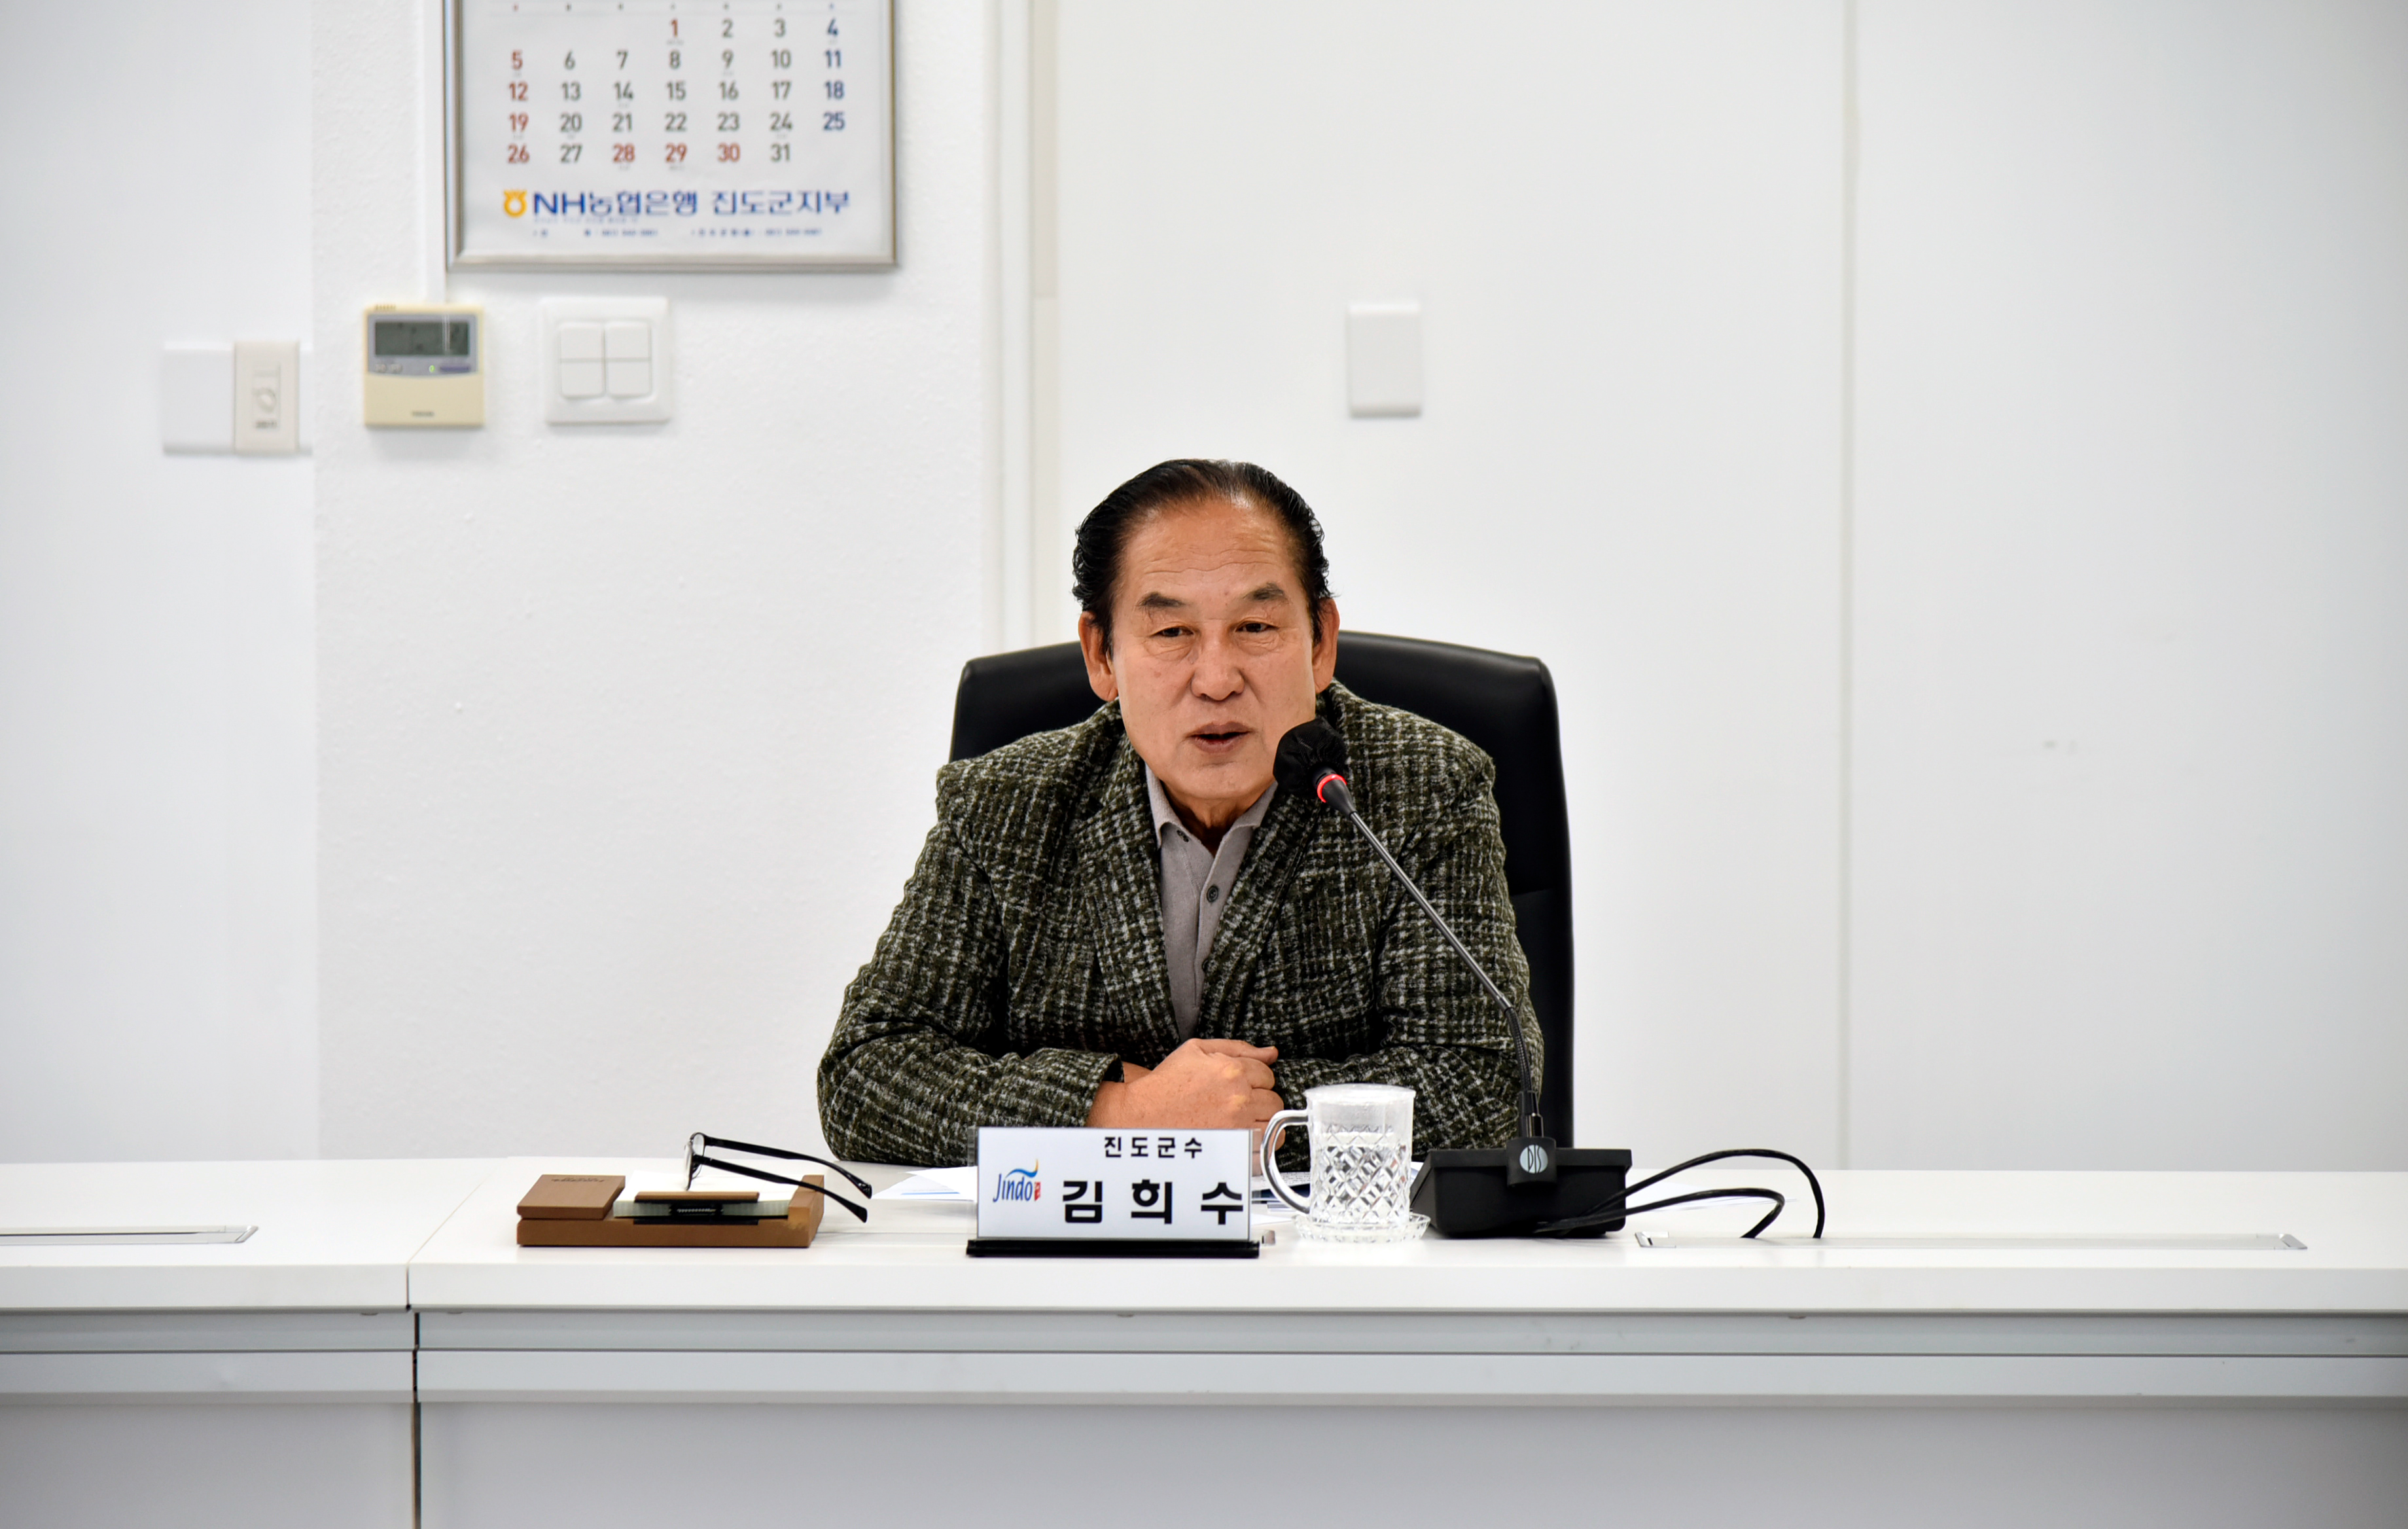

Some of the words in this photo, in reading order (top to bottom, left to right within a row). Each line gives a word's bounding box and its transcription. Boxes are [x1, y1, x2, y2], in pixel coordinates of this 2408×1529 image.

[671, 19, 679, 37] 1
[722, 19, 733, 38] 2
[775, 18, 786, 37] 3
[826, 18, 839, 37] 4
[512, 50, 523, 70] 5
[564, 51, 576, 69] 6
[617, 50, 628, 69] 7
[669, 50, 681, 69] 8
[722, 50, 734, 68] 9
[771, 50, 792, 69] 10
[824, 49, 841, 68] 11
[508, 82, 528, 101] 12
[561, 82, 581, 101] 13
[614, 82, 634, 100] 14
[667, 81, 686, 101] 15
[719, 81, 739, 100] 16
[772, 81, 792, 99] 17
[824, 81, 845, 100] 18
[509, 113, 529, 132] 19
[560, 113, 582, 132] 20
[613, 113, 632, 132] 21
[665, 113, 687, 132] 22
[718, 113, 740, 132] 23
[770, 112, 793, 132] 24
[823, 111, 846, 132] 25
[508, 144, 530, 164] 26
[560, 144, 583, 163] 27
[612, 143, 635, 163] 28
[665, 143, 688, 163] 29
[718, 143, 741, 163] 30
[771, 143, 790, 162] 31
[533, 190, 698, 217] NH농협은행
[711, 190, 850, 215] 진도군지부
[1104, 1136, 1203, 1159] 진도군수
[993, 1174, 1033, 1202] Jindo
[1062, 1179, 1244, 1225] 김희수
